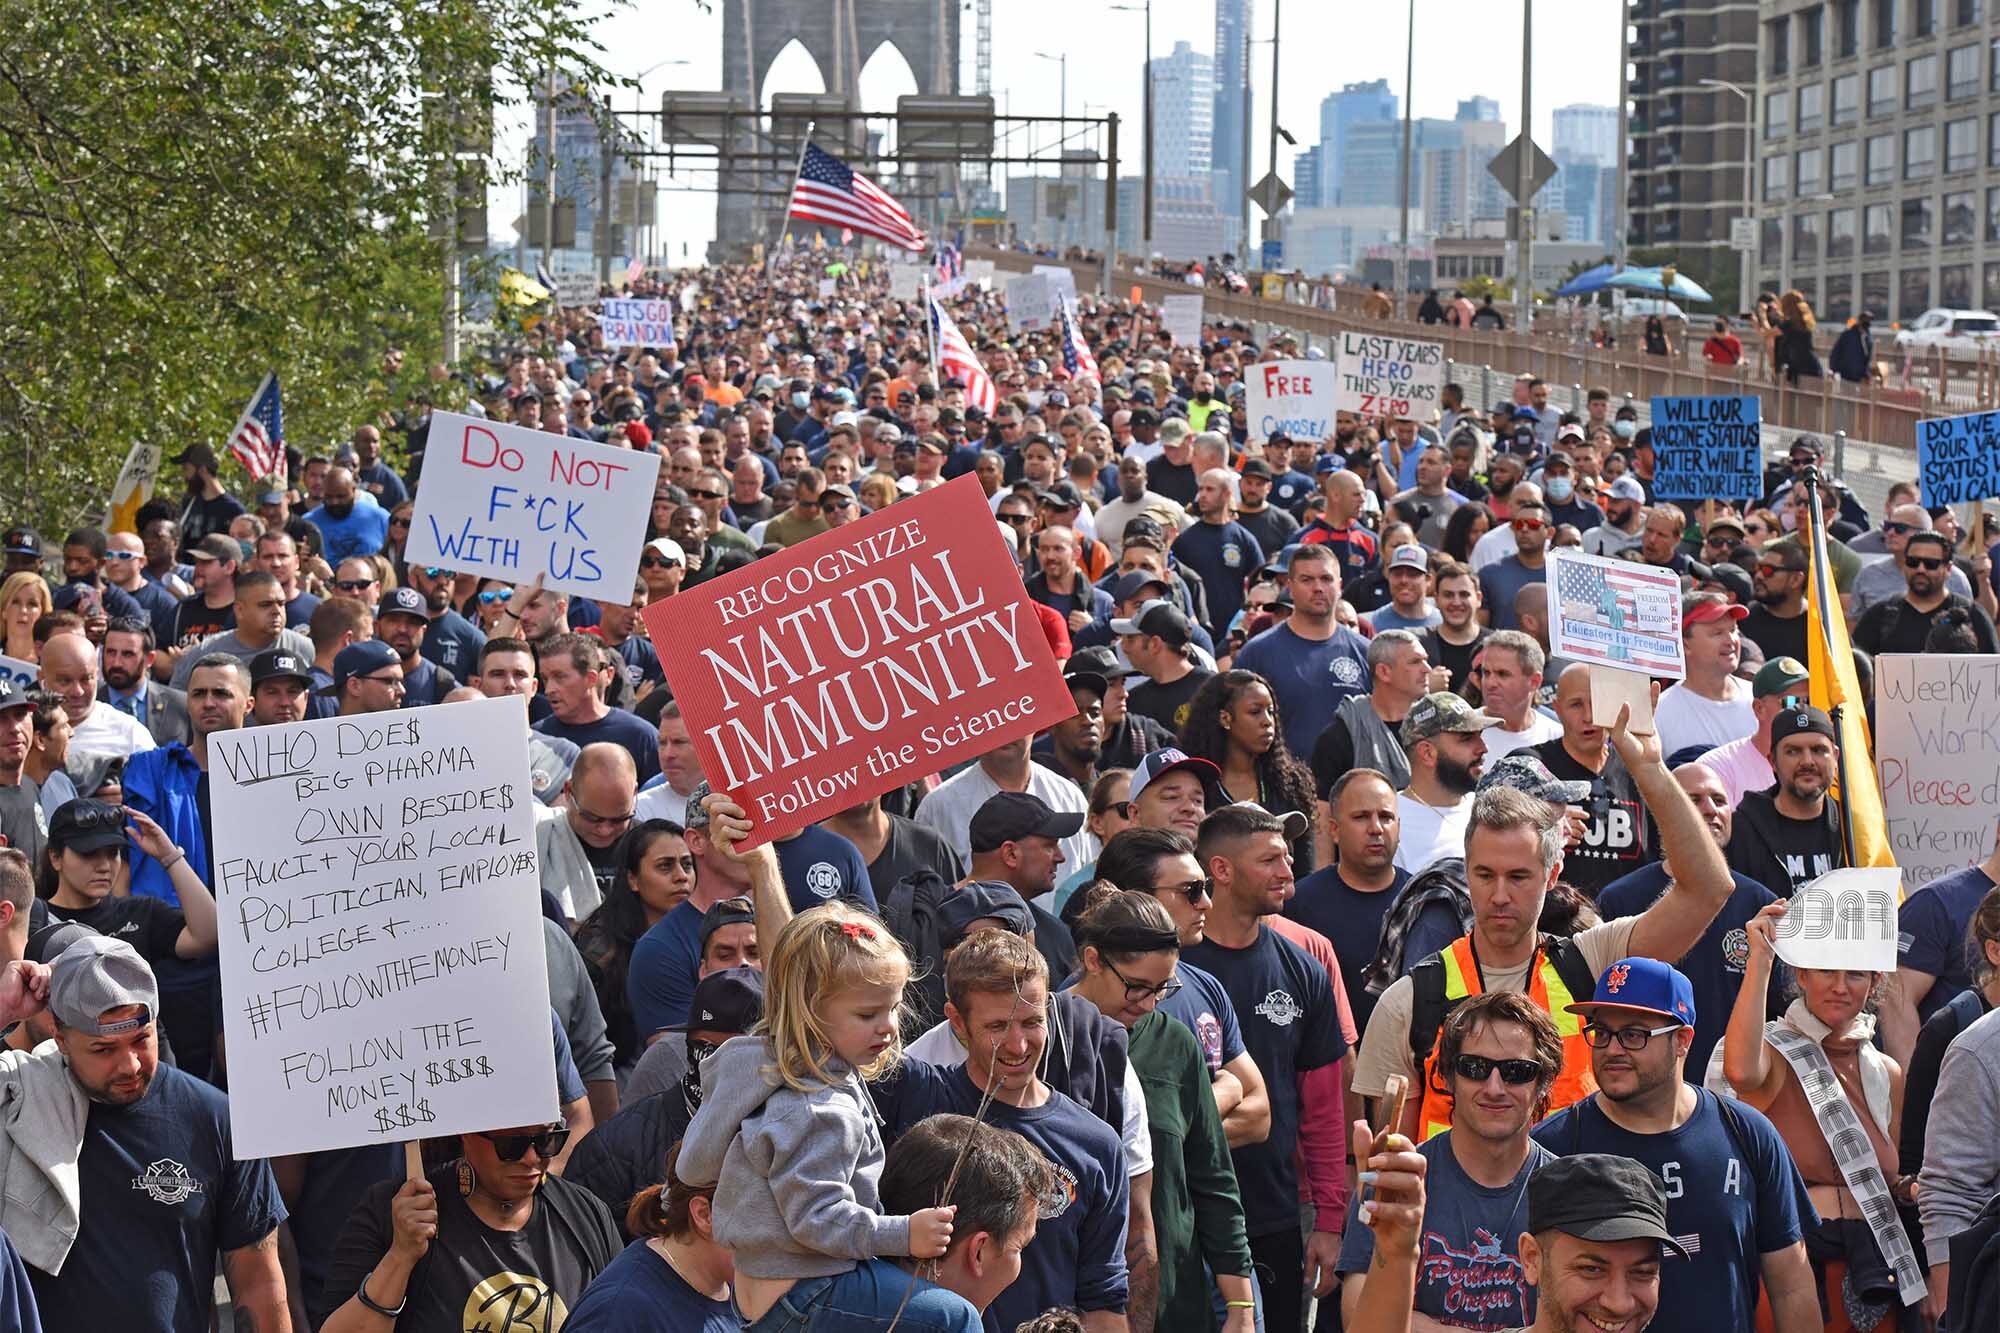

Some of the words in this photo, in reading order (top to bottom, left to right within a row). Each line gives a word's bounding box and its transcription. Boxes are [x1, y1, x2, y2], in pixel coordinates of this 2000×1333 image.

[646, 303, 669, 322] GO
[605, 323, 672, 345] BRANDON
[1345, 334, 1392, 360] LAST
[1264, 366, 1312, 398] FREE
[1344, 375, 1385, 395] THIS
[1362, 358, 1412, 380] HERO
[1360, 395, 1410, 416] ZERO
[1664, 399, 1709, 421] WILL
[1709, 397, 1743, 423] OUR
[1651, 423, 1705, 448] VACCINE
[1705, 422, 1760, 448] STATUS
[1926, 420, 1953, 441] DO
[1964, 413, 1997, 435] WE
[1654, 448, 1704, 473] MATTER
[1705, 449, 1756, 474] WHILE
[1928, 437, 1969, 463] YOUR
[550, 450, 629, 490] NOT
[1655, 471, 1696, 495] SAVING
[1727, 475, 1761, 498] LIFE?
[1925, 454, 1989, 485] STATUS
[1928, 482, 1961, 508] YOU
[429, 514, 519, 568] WITH
[549, 541, 602, 582] US
[714, 518, 928, 626] RECOGNIZE
[1636, 594, 1669, 604] FREEDOM
[700, 548, 985, 712] NATURAL
[1640, 615, 1671, 624] RELIGION
[1567, 621, 1613, 642] Educators
[1615, 632, 1632, 646] For
[1633, 636, 1675, 655] Freedom
[704, 601, 1033, 792] IMMUNITY
[216, 730, 317, 784] WHO
[295, 773, 355, 801] BIG
[365, 746, 475, 787] PHARMA
[756, 764, 860, 824] Follow
[865, 743, 917, 777] the
[921, 694, 1037, 756] Science
[1881, 758, 1976, 809] Please
[295, 804, 383, 845] OWN
[1584, 808, 1634, 848] JB
[220, 852, 319, 894] FAUCI
[351, 833, 418, 880] YOUR
[428, 823, 521, 858] LOCAL
[1952, 824, 1986, 865] my
[817, 872, 832, 887] 68
[1901, 864, 1957, 885] areer
[240, 873, 428, 943] POLITICIAN,
[252, 924, 376, 973] COLLEGE
[243, 931, 512, 1040] #FOLLOWTHEMONEY
[281, 1034, 403, 1091] FOLLOW
[412, 1017, 481, 1050] THE
[327, 1069, 417, 1118] MONEY
[425, 1055, 494, 1087] $$$$
[368, 1097, 437, 1134] $$$
[1058, 1165, 1080, 1187] HOUSE
[1424, 1255, 1516, 1288] Portland
[1444, 1284, 1513, 1322] Oregon
